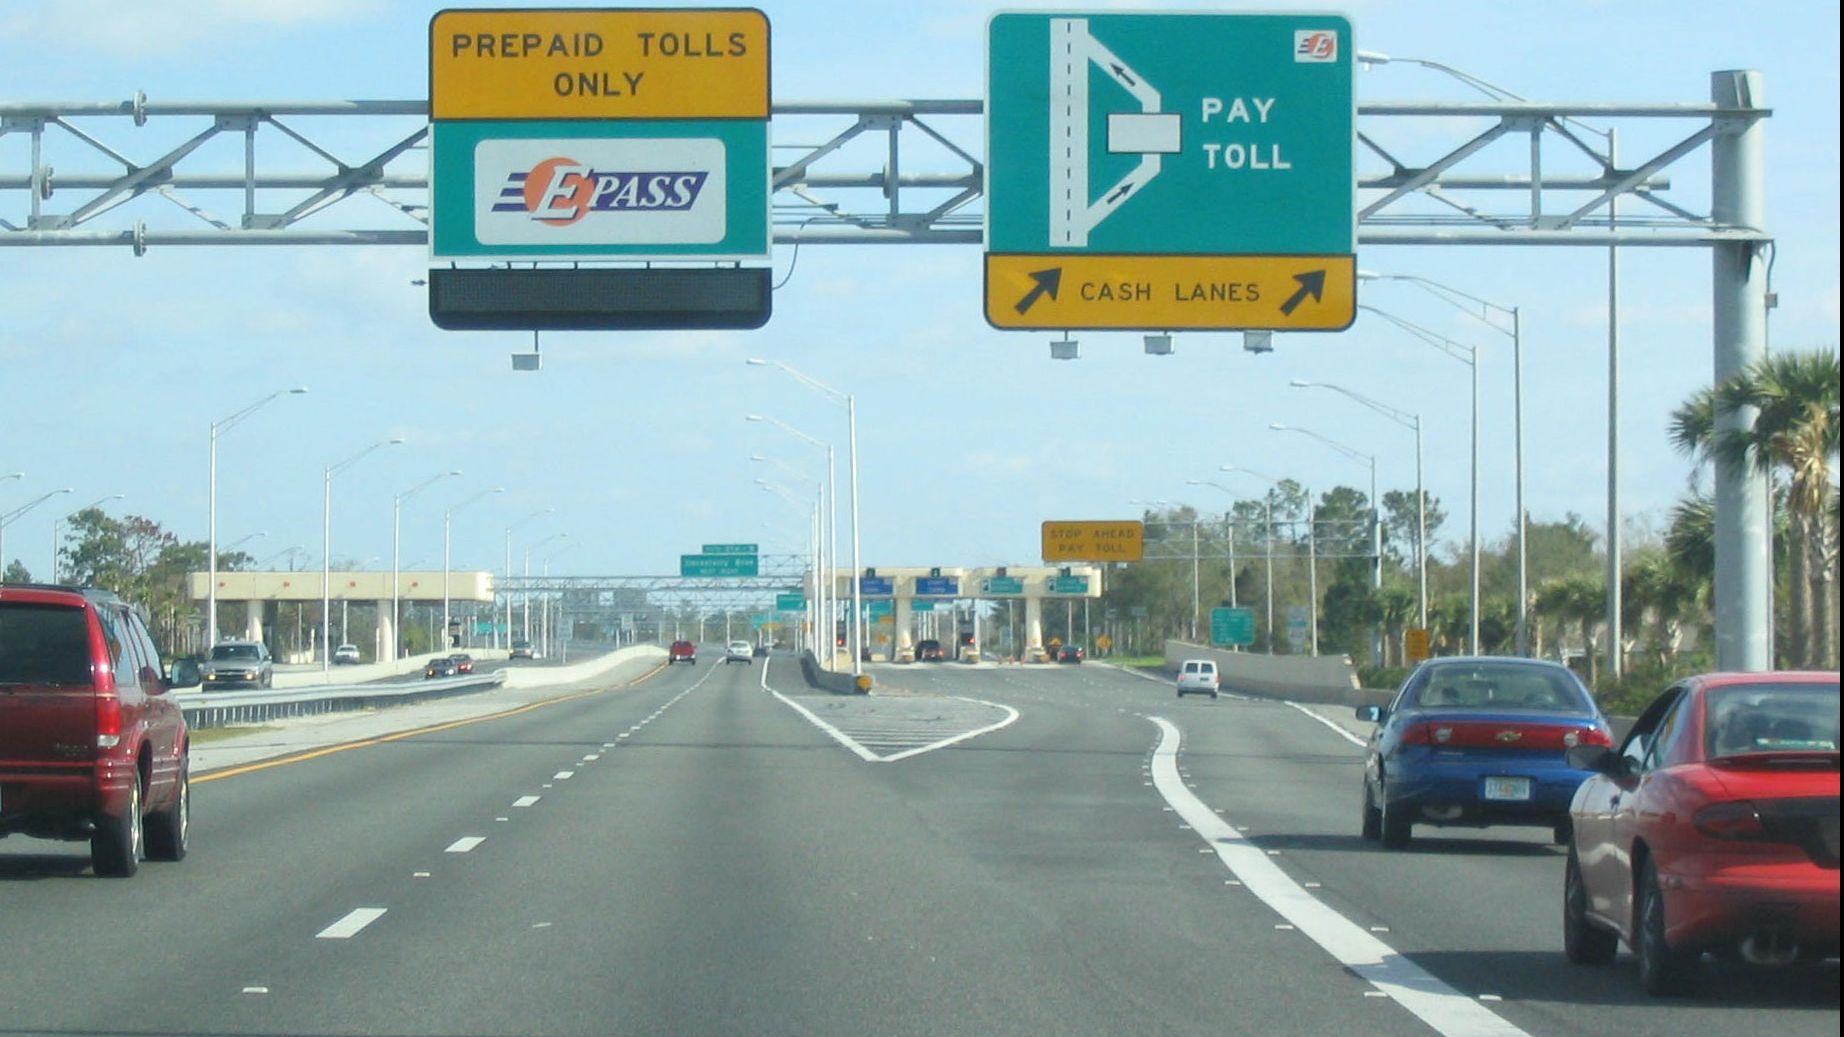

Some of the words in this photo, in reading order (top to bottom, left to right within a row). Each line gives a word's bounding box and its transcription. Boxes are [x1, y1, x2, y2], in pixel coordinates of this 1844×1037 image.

[452, 33, 604, 58] PREPAID
[637, 32, 748, 57] TOLLS
[554, 72, 645, 97] ONLY
[1201, 97, 1276, 124] PAY
[1203, 143, 1293, 170] TOLL
[1080, 282, 1152, 302] CASH
[1175, 283, 1261, 302] LANES
[1050, 527, 1083, 539] STOP
[1093, 527, 1135, 539] AHEAD
